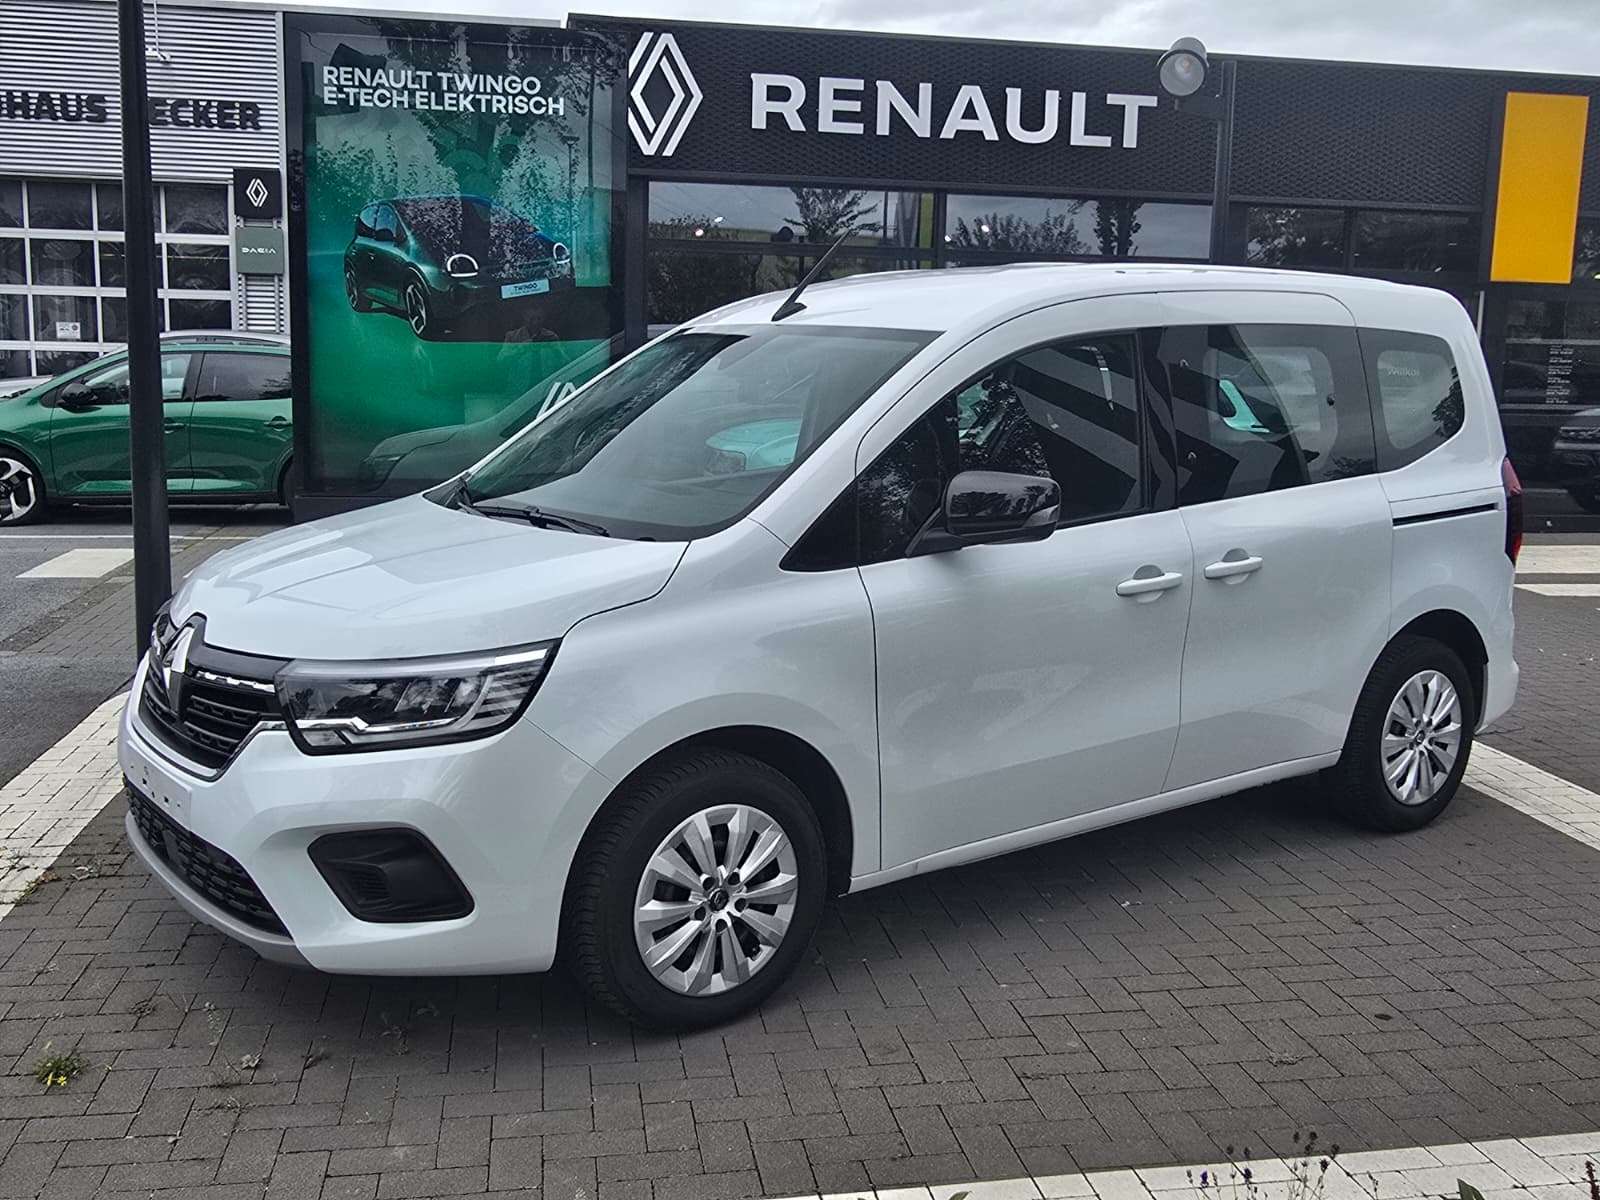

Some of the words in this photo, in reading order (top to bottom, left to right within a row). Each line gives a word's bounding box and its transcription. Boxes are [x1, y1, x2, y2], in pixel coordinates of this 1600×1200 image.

[323, 65, 432, 89] RENAULT
[437, 71, 541, 94] TWINGO
[0, 90, 108, 123] HAUS
[147, 97, 261, 130] ECKER
[323, 86, 409, 108] E-TECH
[415, 91, 565, 116] ELEKTRISCH
[750, 72, 1158, 149] RENAULT
